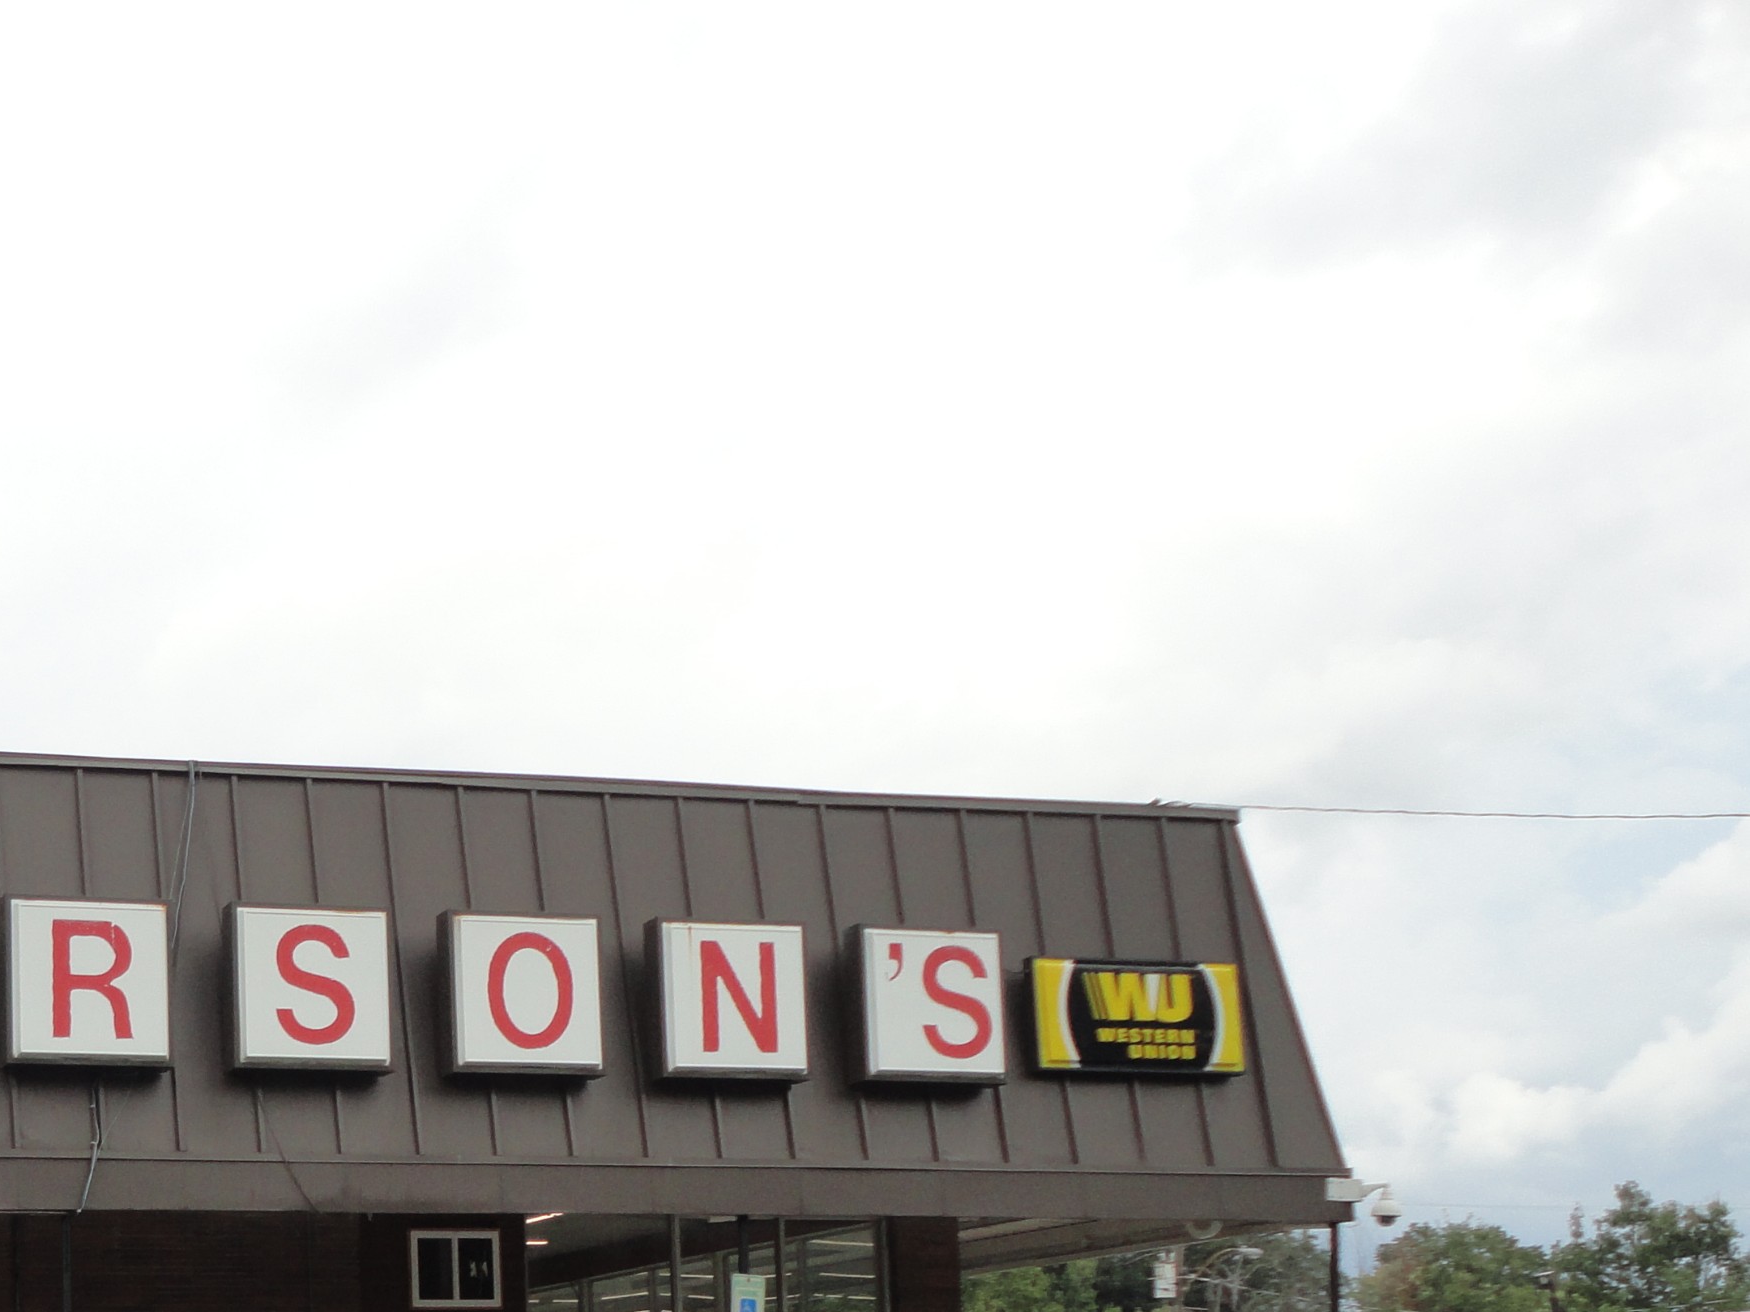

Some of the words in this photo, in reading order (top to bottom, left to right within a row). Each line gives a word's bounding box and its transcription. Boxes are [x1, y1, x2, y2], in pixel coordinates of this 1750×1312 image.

[1082, 971, 1195, 1022] WU
[1095, 1027, 1196, 1044] WESTERN
[1126, 1044, 1197, 1060] UNION
